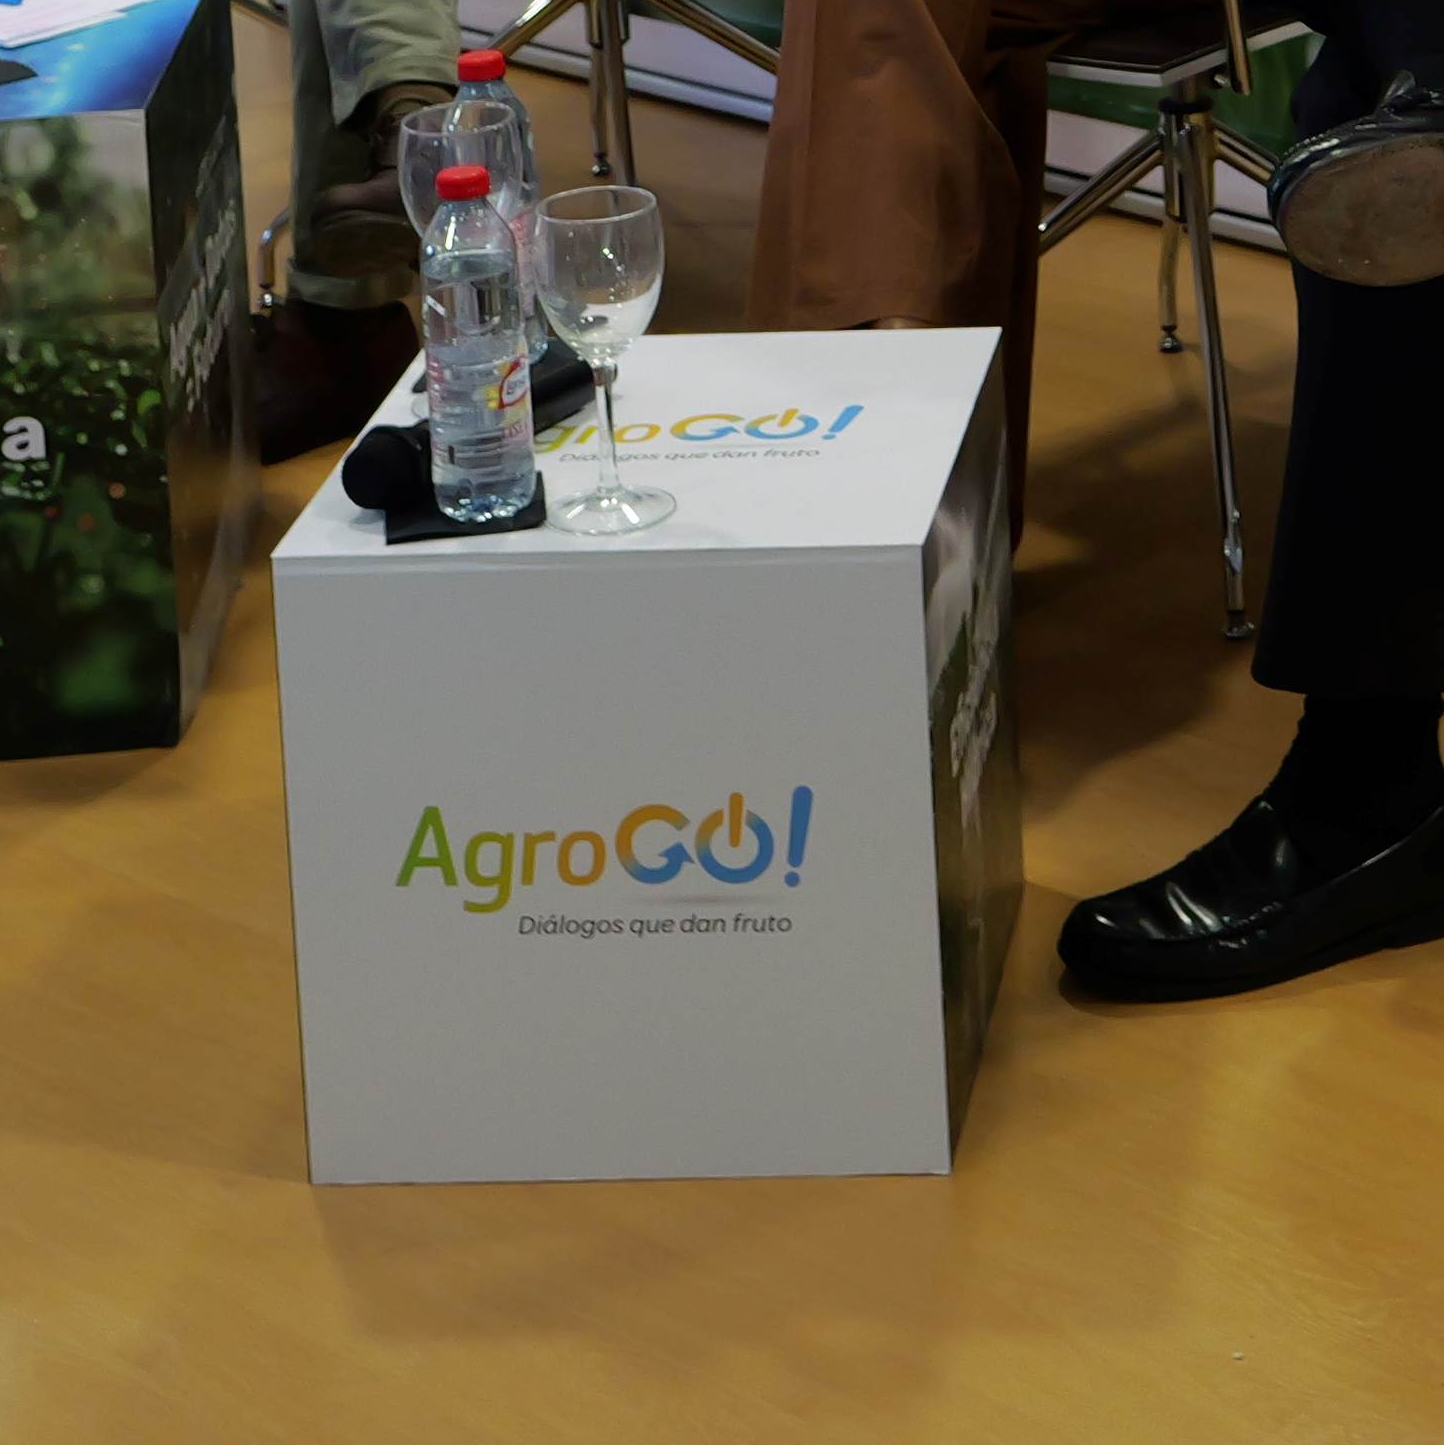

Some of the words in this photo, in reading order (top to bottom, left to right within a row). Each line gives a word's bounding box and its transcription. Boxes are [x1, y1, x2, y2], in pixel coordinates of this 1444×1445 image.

[534, 404, 865, 454] groGO!
[518, 913, 624, 940] Diálogos
[629, 918, 676, 939] que
[679, 912, 727, 933] dan
[732, 912, 793, 934] fruto
